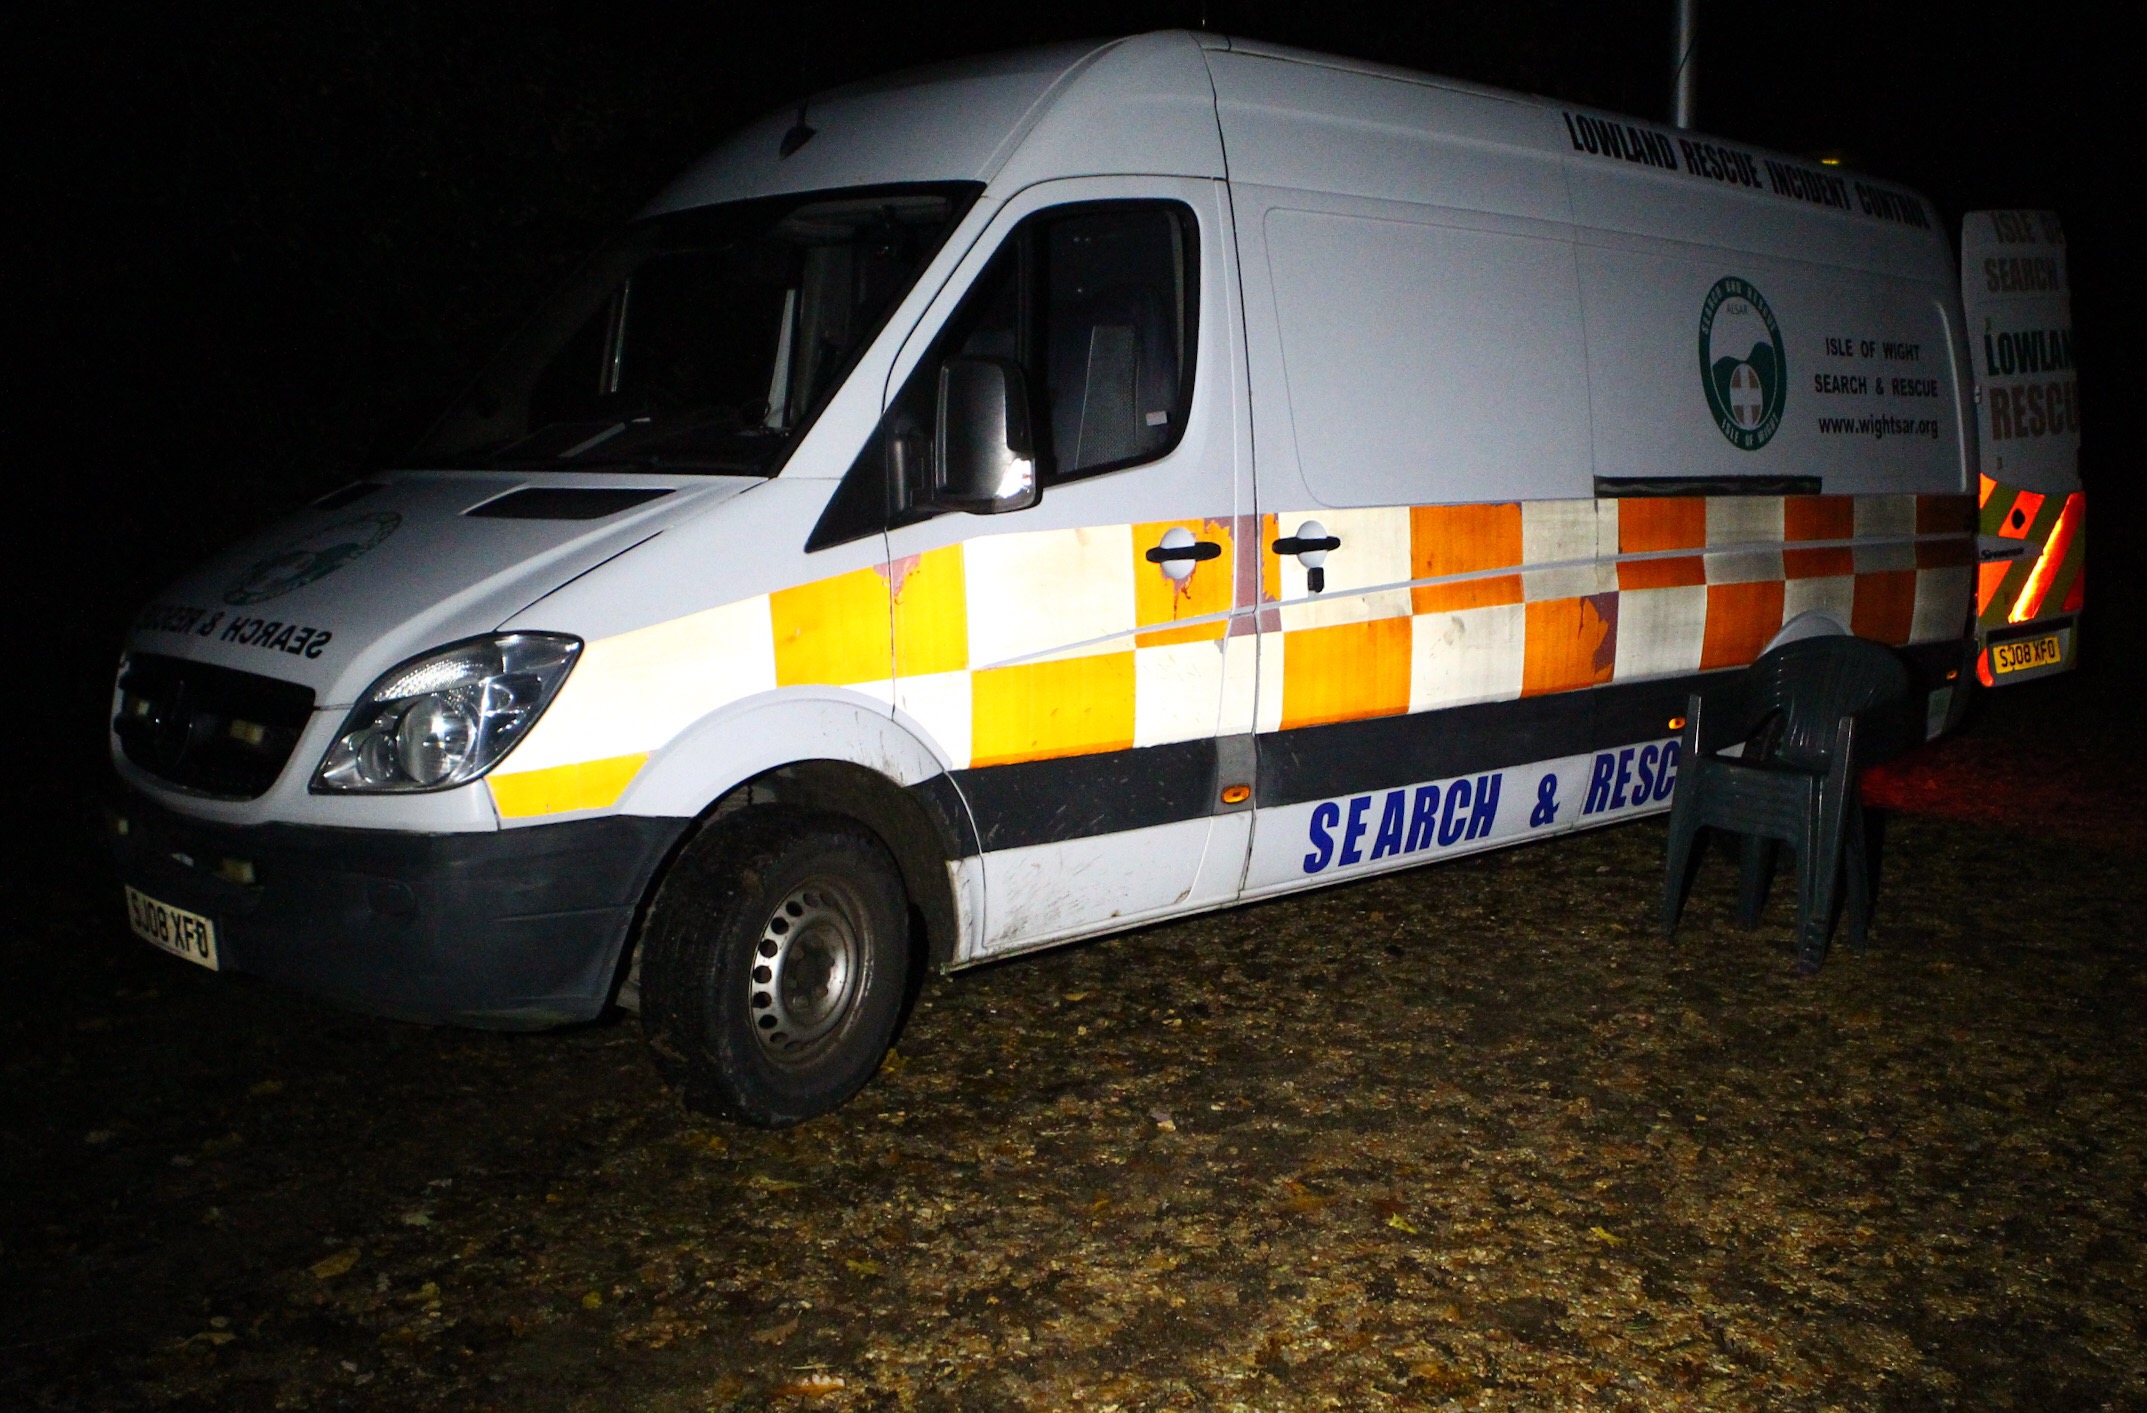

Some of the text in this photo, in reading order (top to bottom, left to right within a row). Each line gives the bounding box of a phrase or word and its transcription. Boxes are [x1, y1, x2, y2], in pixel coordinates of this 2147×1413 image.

[1562, 111, 1931, 230] LOWLAND RESCUE INCIDENT CONTROL
[1990, 210, 2036, 244] ISLE
[1984, 257, 2060, 292] SEARCH
[1825, 337, 1920, 361] ISLE OF WIGHT
[1814, 374, 1938, 398] SEARCH & RESCUE
[1818, 414, 1939, 439] www.wightsar.org
[1999, 643, 2032, 668] SJ08
[1303, 773, 1503, 874] SEARCH
[1530, 773, 1560, 828] &
[131, 892, 169, 943] SJ08
